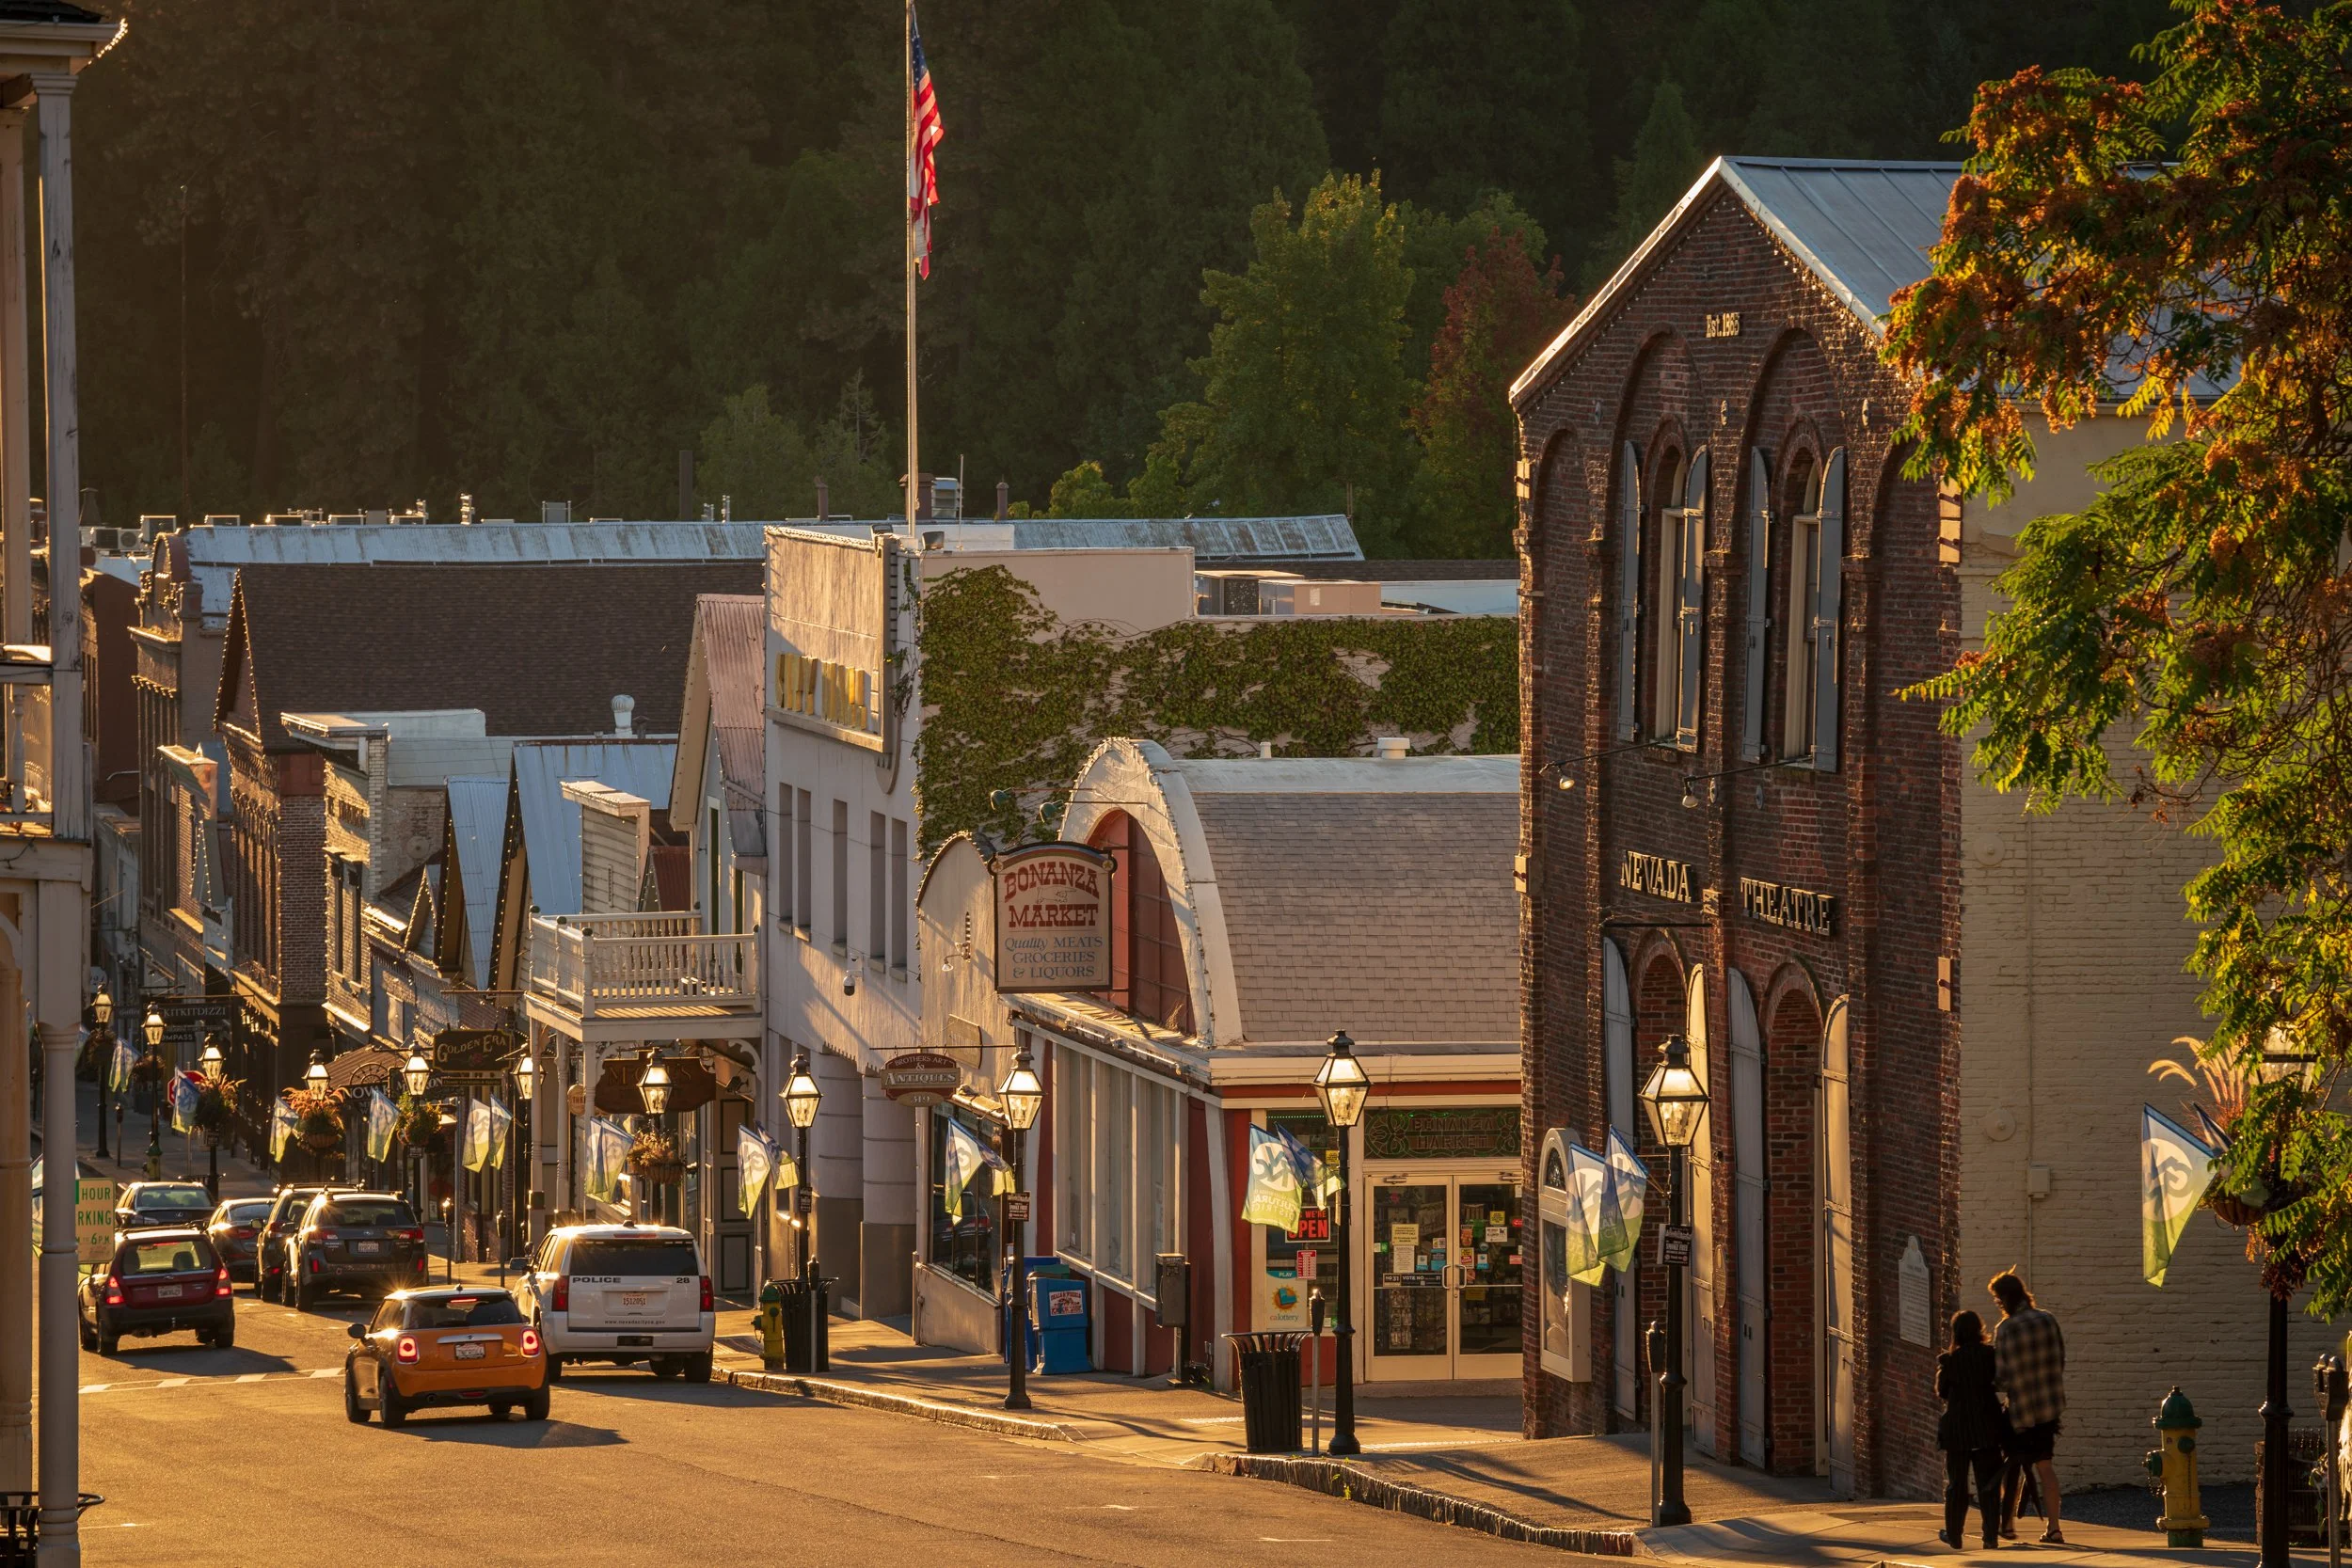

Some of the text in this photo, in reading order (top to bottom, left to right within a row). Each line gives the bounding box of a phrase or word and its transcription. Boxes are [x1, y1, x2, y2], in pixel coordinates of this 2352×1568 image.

[1004, 862, 1099, 903] BONANZA
[1620, 850, 1835, 936] NEVADA THEATRE
[1009, 904, 1099, 927] MARKET
[1004, 937, 1103, 952] Quality MEATS
[1012, 951, 1095, 964] GROCERIES
[1013, 965, 1095, 980] & LIQUORS
[164, 1006, 226, 1018] KITKITDIZZI
[162, 1033, 193, 1041] OMPASS
[437, 1035, 506, 1063] GOLDEN ERA
[895, 1055, 948, 1066] BROTHERS ART
[915, 1062, 925, 1071] &
[1414, 1117, 1495, 1131] BONANZA
[1418, 1136, 1487, 1148] MARKET
[81, 1187, 111, 1200] HOUR
[77, 1210, 112, 1227] RKING
[91, 1233, 97, 1245] 6
